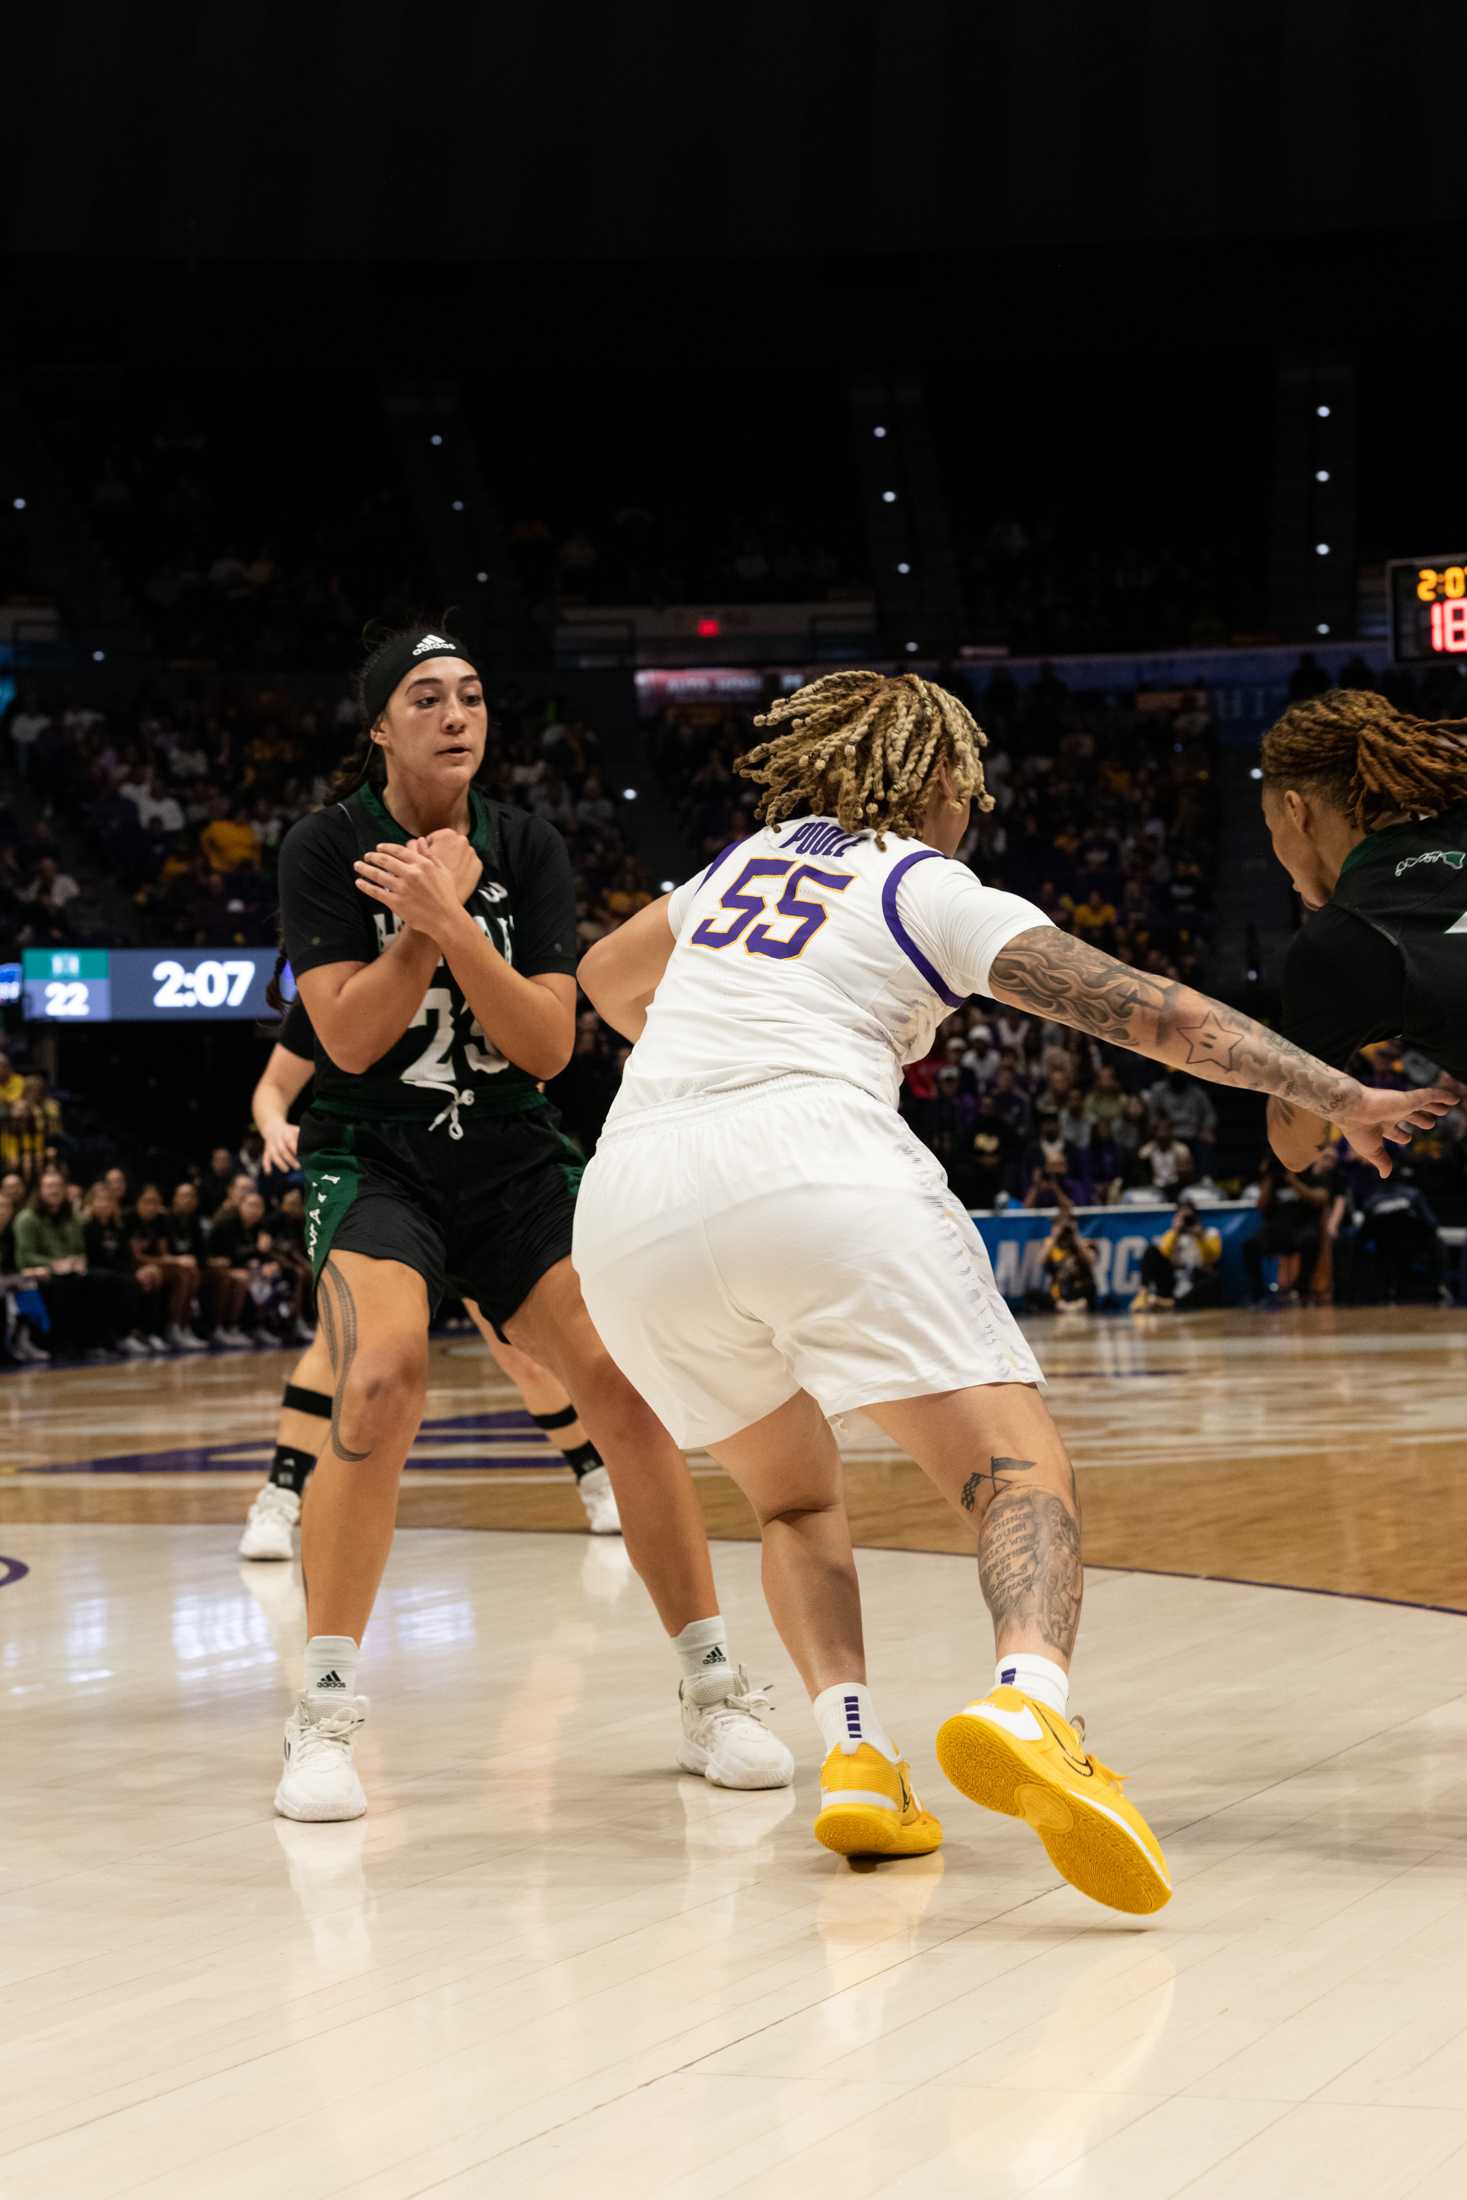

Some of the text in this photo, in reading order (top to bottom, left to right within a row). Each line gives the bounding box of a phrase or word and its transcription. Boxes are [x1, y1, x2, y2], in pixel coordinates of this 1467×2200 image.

[1417, 566, 1467, 602] 2:0
[691, 857, 857, 960] 55
[44, 982, 90, 1016] 22
[152, 960, 256, 1008] 2:07
